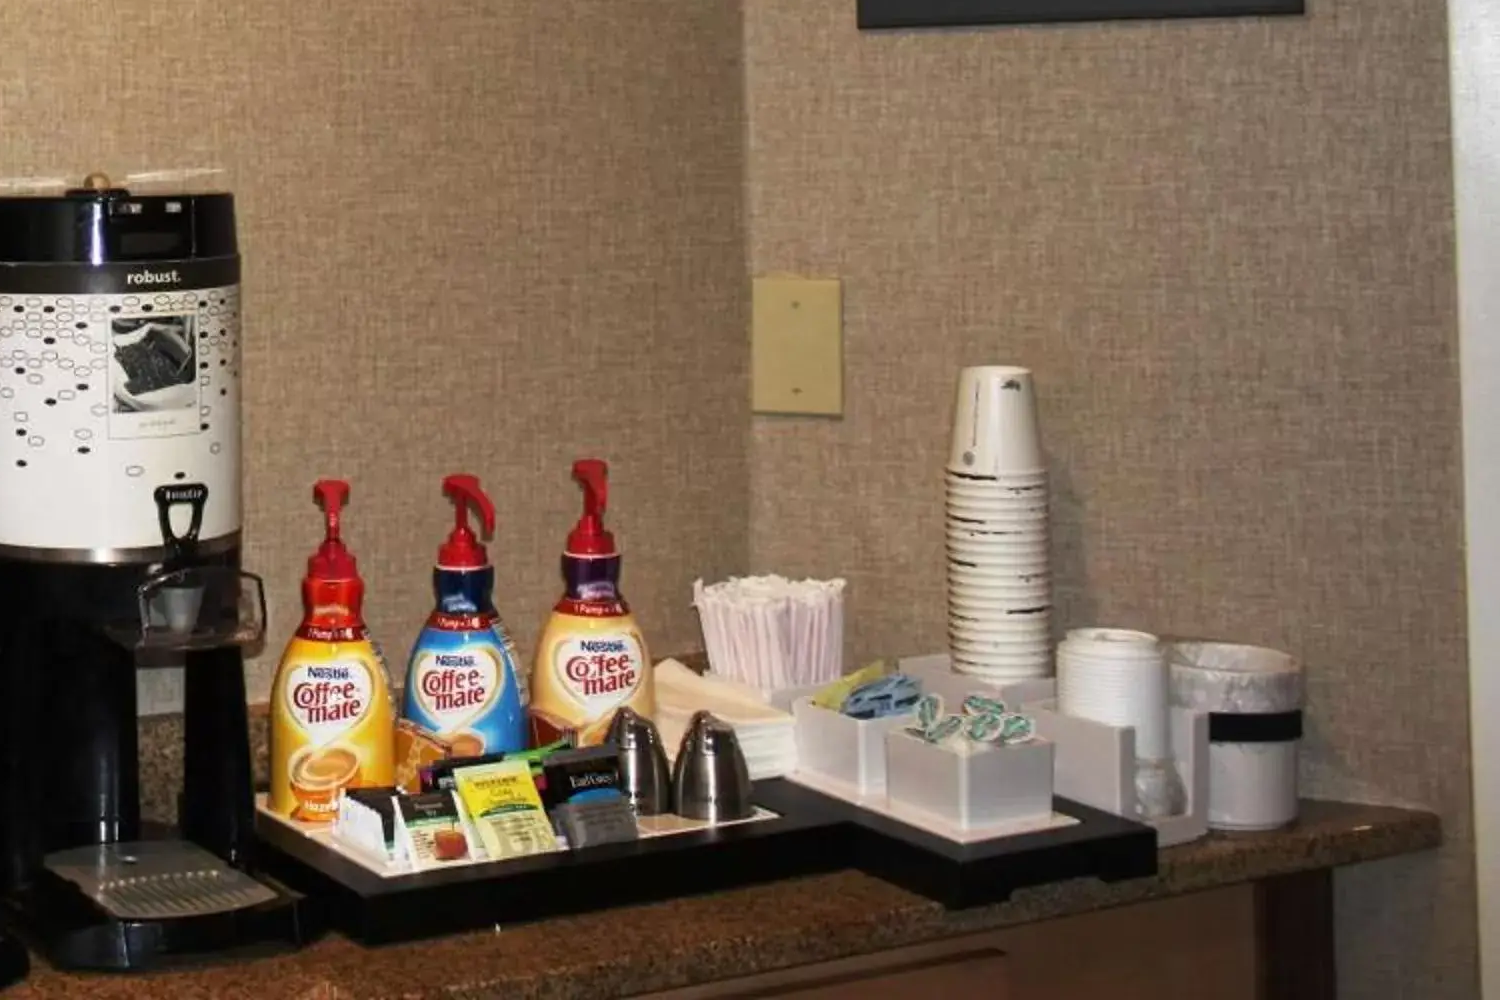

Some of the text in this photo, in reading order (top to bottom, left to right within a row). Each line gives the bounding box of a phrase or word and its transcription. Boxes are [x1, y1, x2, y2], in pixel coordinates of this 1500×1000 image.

[127, 269, 182, 285] robust.
[582, 669, 635, 695] mate
[435, 686, 485, 711] mate
[308, 699, 361, 724] mate
